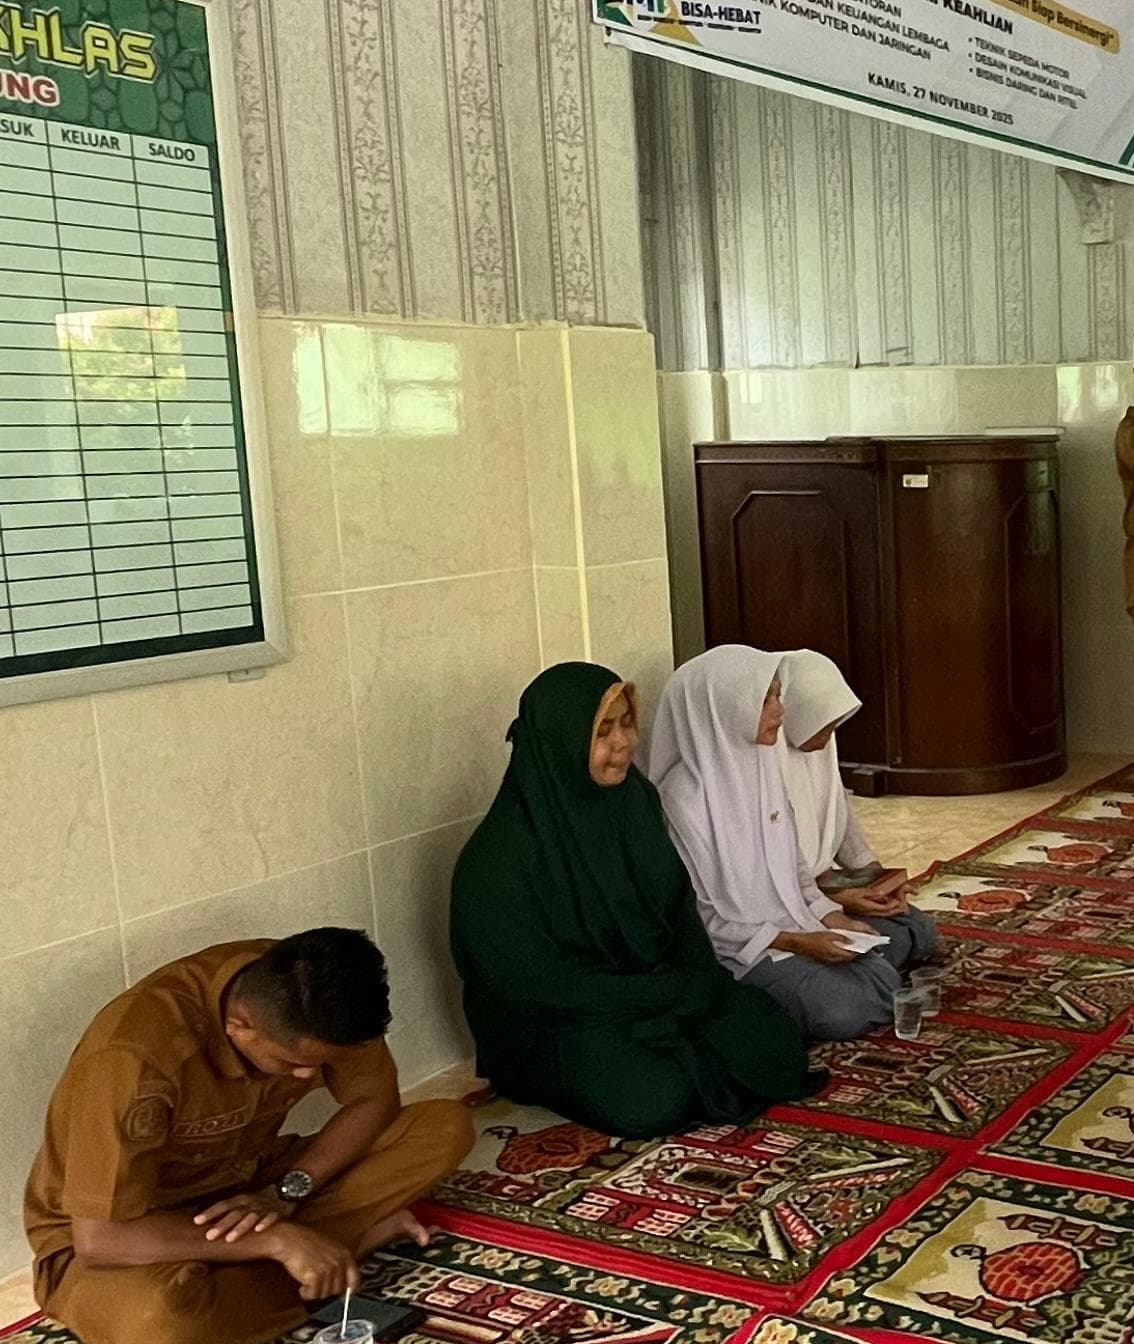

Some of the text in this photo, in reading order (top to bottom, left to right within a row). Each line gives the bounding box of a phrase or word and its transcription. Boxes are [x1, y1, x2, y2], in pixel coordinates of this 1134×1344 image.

[681, 0, 761, 25] BISA-HEBAT
[837, 2, 900, 34] KEUANGAN
[902, 26, 950, 52] LEMBAGA
[1031, 0, 1055, 23] Siap
[780, 0, 849, 33] KOMPUTER
[851, 24, 877, 43] DAN
[878, 34, 932, 60] JARINGAN
[913, 86, 926, 99] 27
[929, 91, 989, 118] NOVEMBER
[61, 129, 121, 151] KELUAR
[148, 142, 195, 162] SALDO
